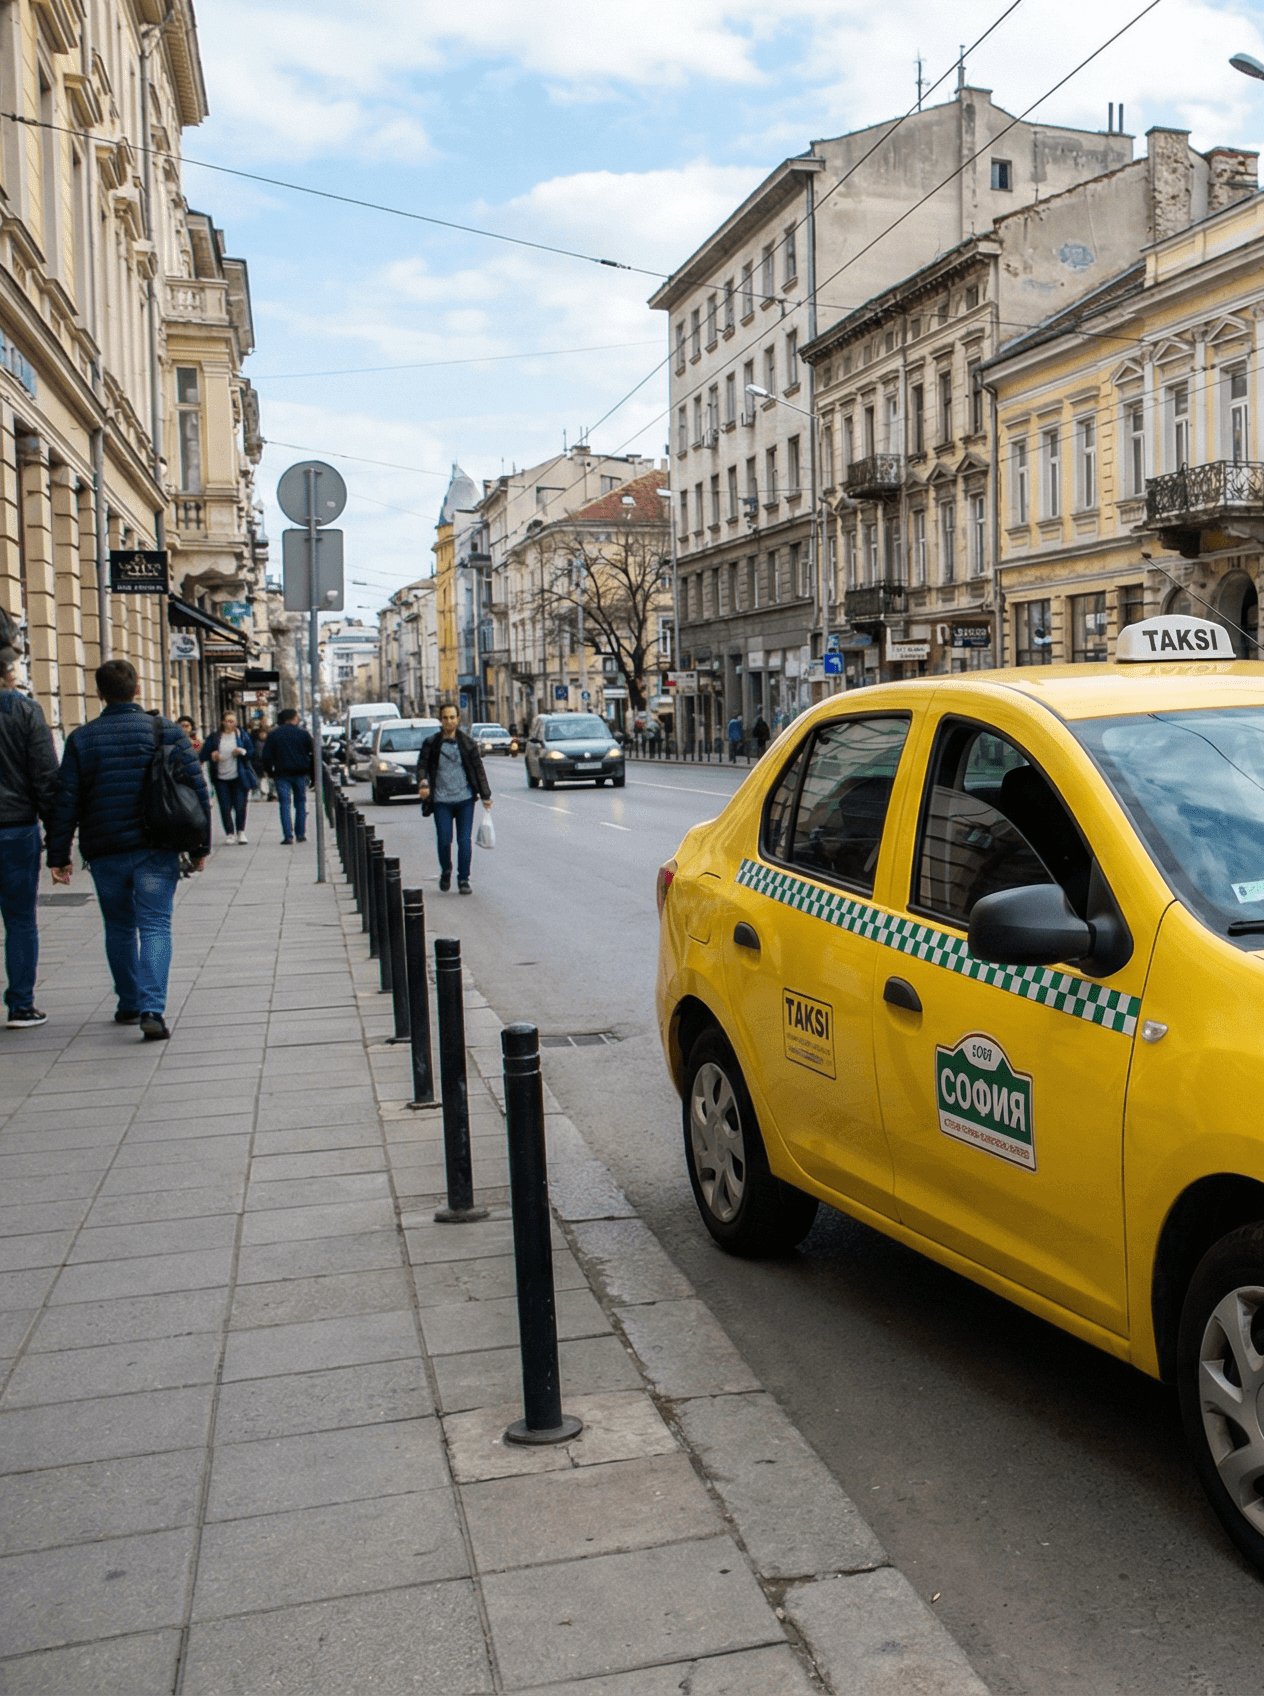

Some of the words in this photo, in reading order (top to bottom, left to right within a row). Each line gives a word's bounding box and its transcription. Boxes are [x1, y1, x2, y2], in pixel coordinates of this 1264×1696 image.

[1142, 629, 1218, 651] TAKSI
[785, 997, 829, 1040] TAKSI
[940, 1067, 1026, 1132] СОФИЯ
